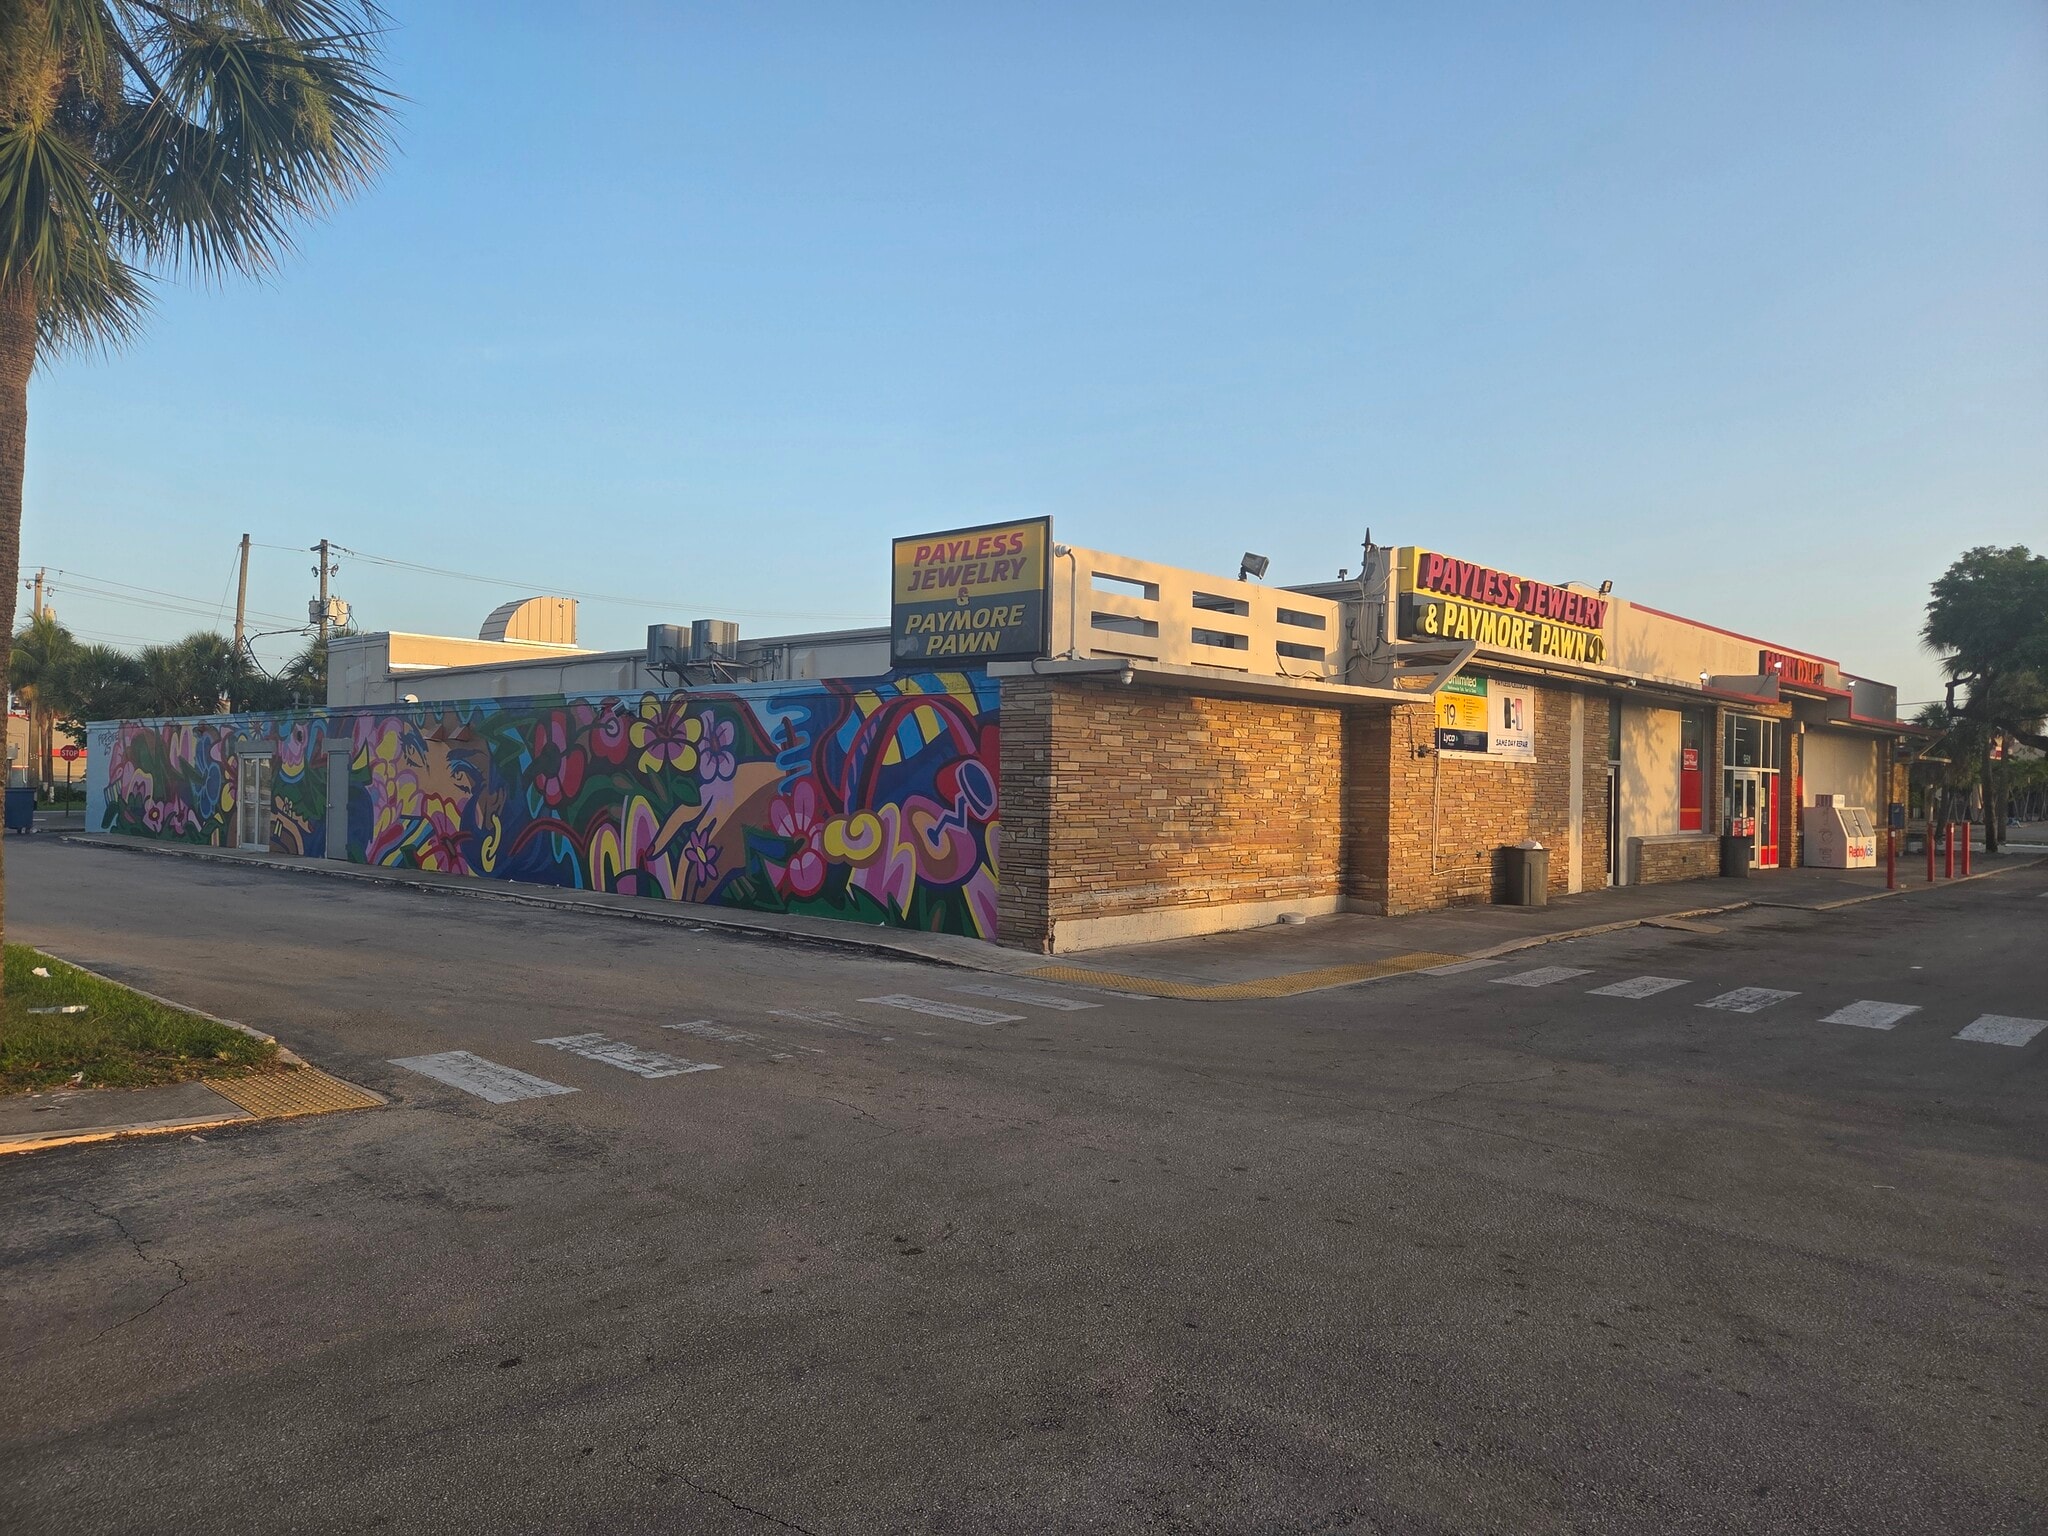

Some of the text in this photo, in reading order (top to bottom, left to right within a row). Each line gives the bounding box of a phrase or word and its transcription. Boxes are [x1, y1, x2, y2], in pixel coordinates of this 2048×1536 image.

[913, 532, 1024, 567] PAYLESS
[907, 557, 1027, 591] JEWELRY
[956, 587, 969, 606] &
[1419, 553, 1608, 629] PAYLESS JEWELRY
[905, 604, 1025, 635] PAYMORE
[1424, 602, 1588, 662] & PAYMORE PAWN
[926, 631, 1001, 655] PAWN
[61, 749, 78, 757] STOP
